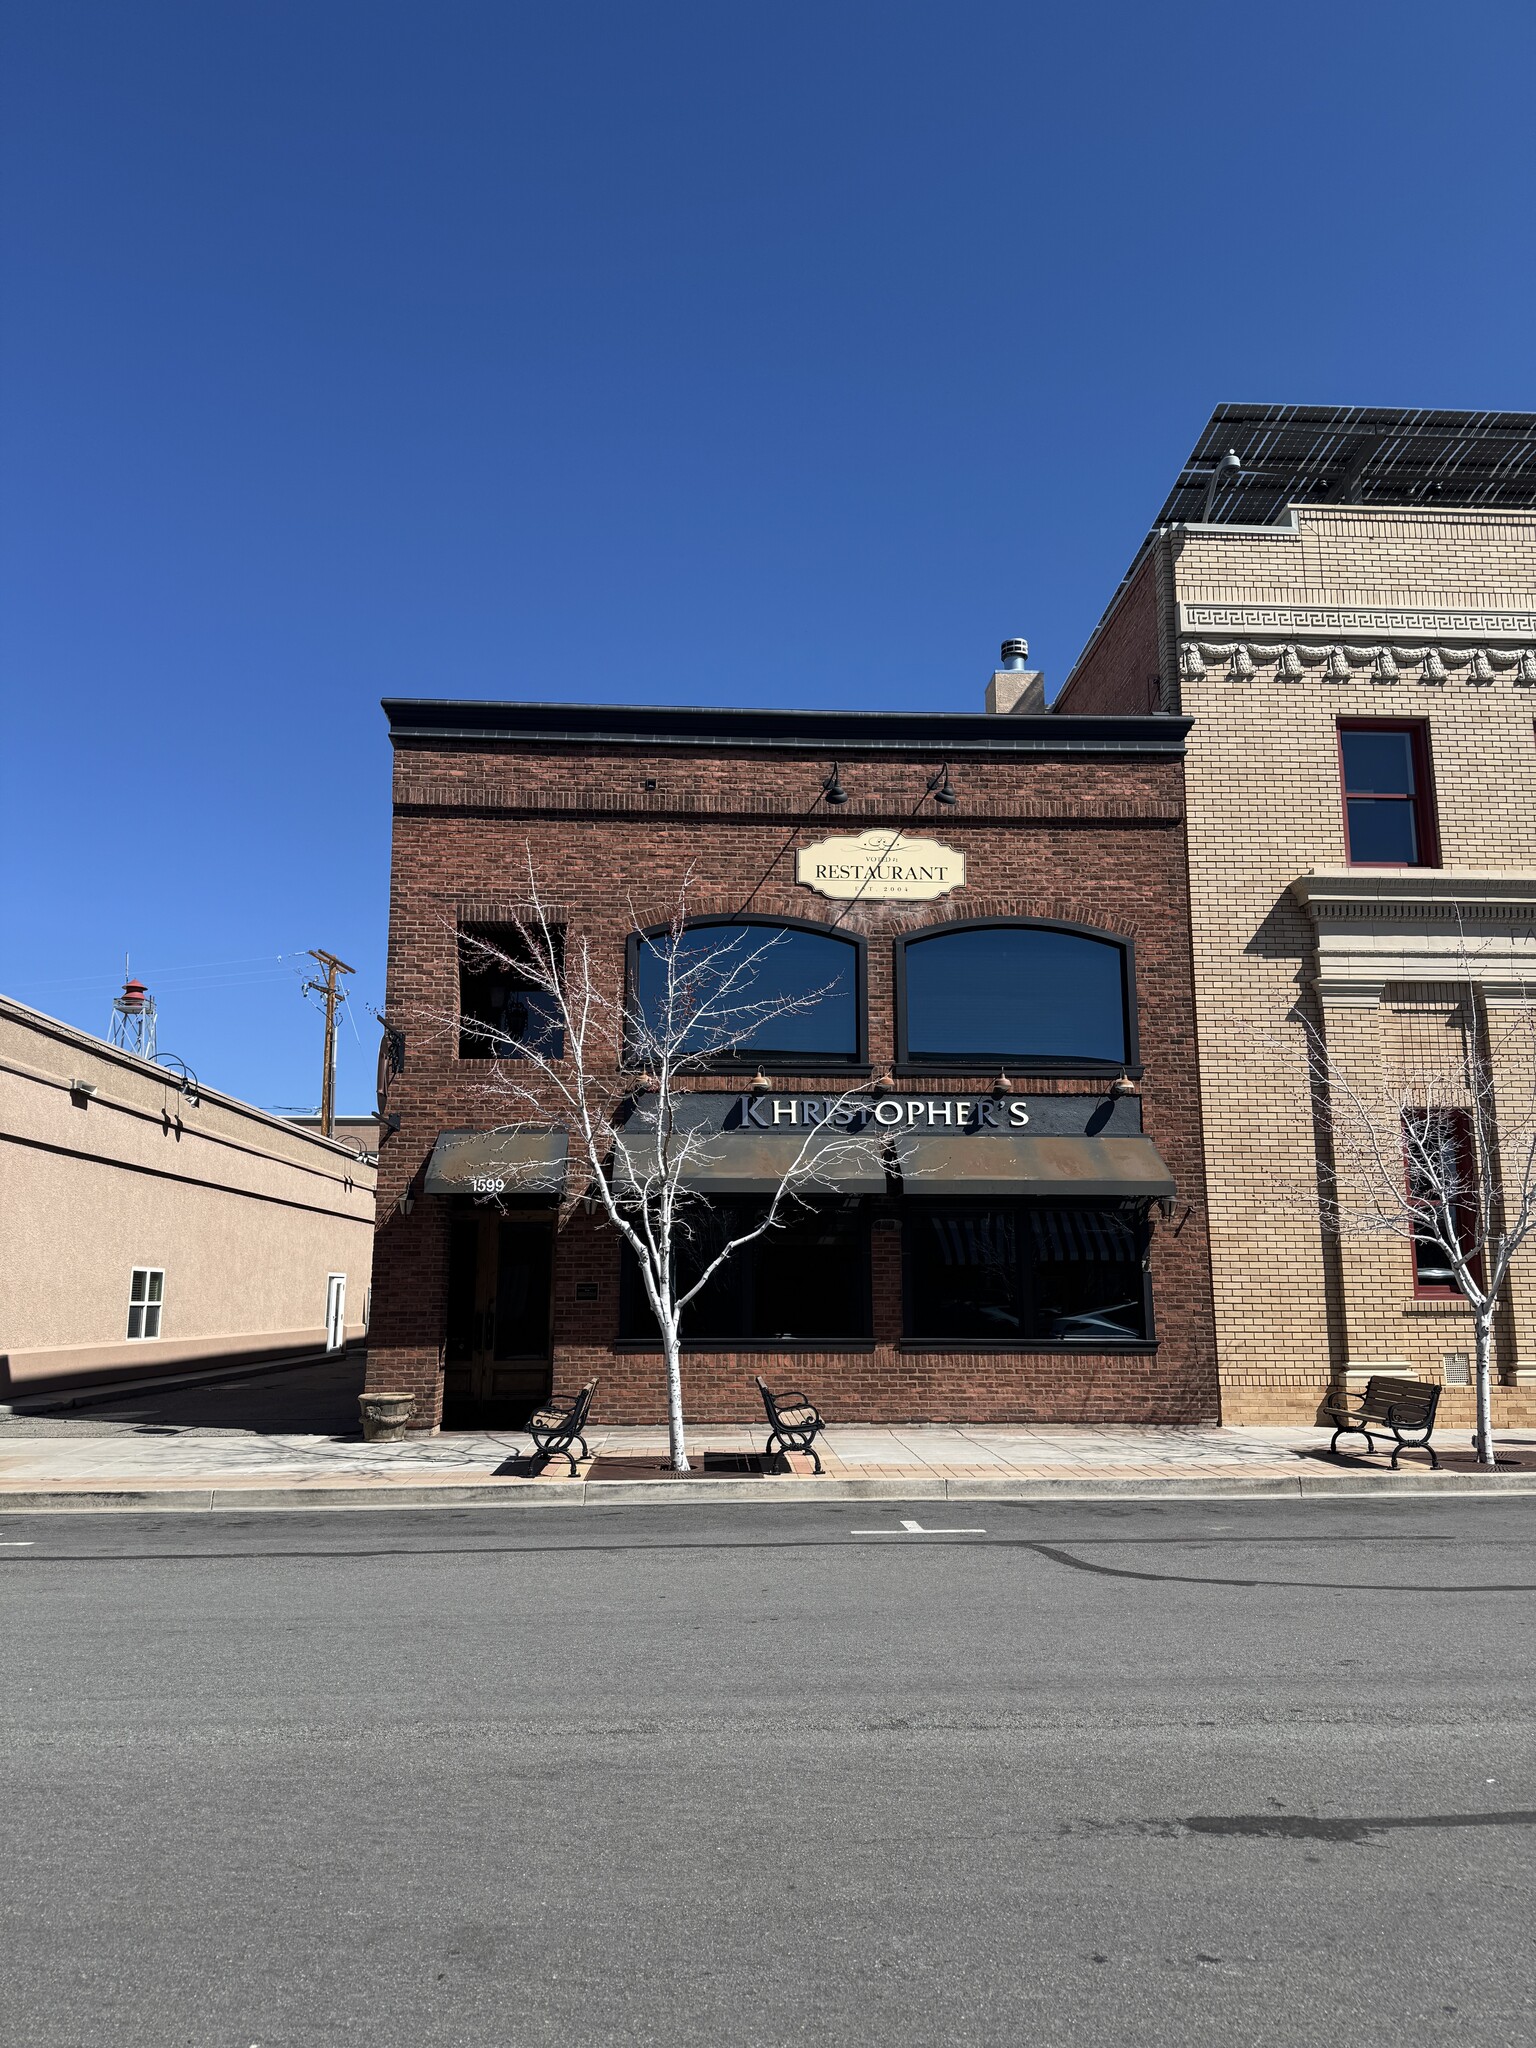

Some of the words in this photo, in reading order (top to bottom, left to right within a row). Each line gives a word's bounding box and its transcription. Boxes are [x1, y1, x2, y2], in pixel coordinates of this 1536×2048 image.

[815, 864, 948, 880] RESTAURANT
[740, 1096, 1029, 1127] KHRISTOPHER'S
[473, 1179, 504, 1192] 1599
